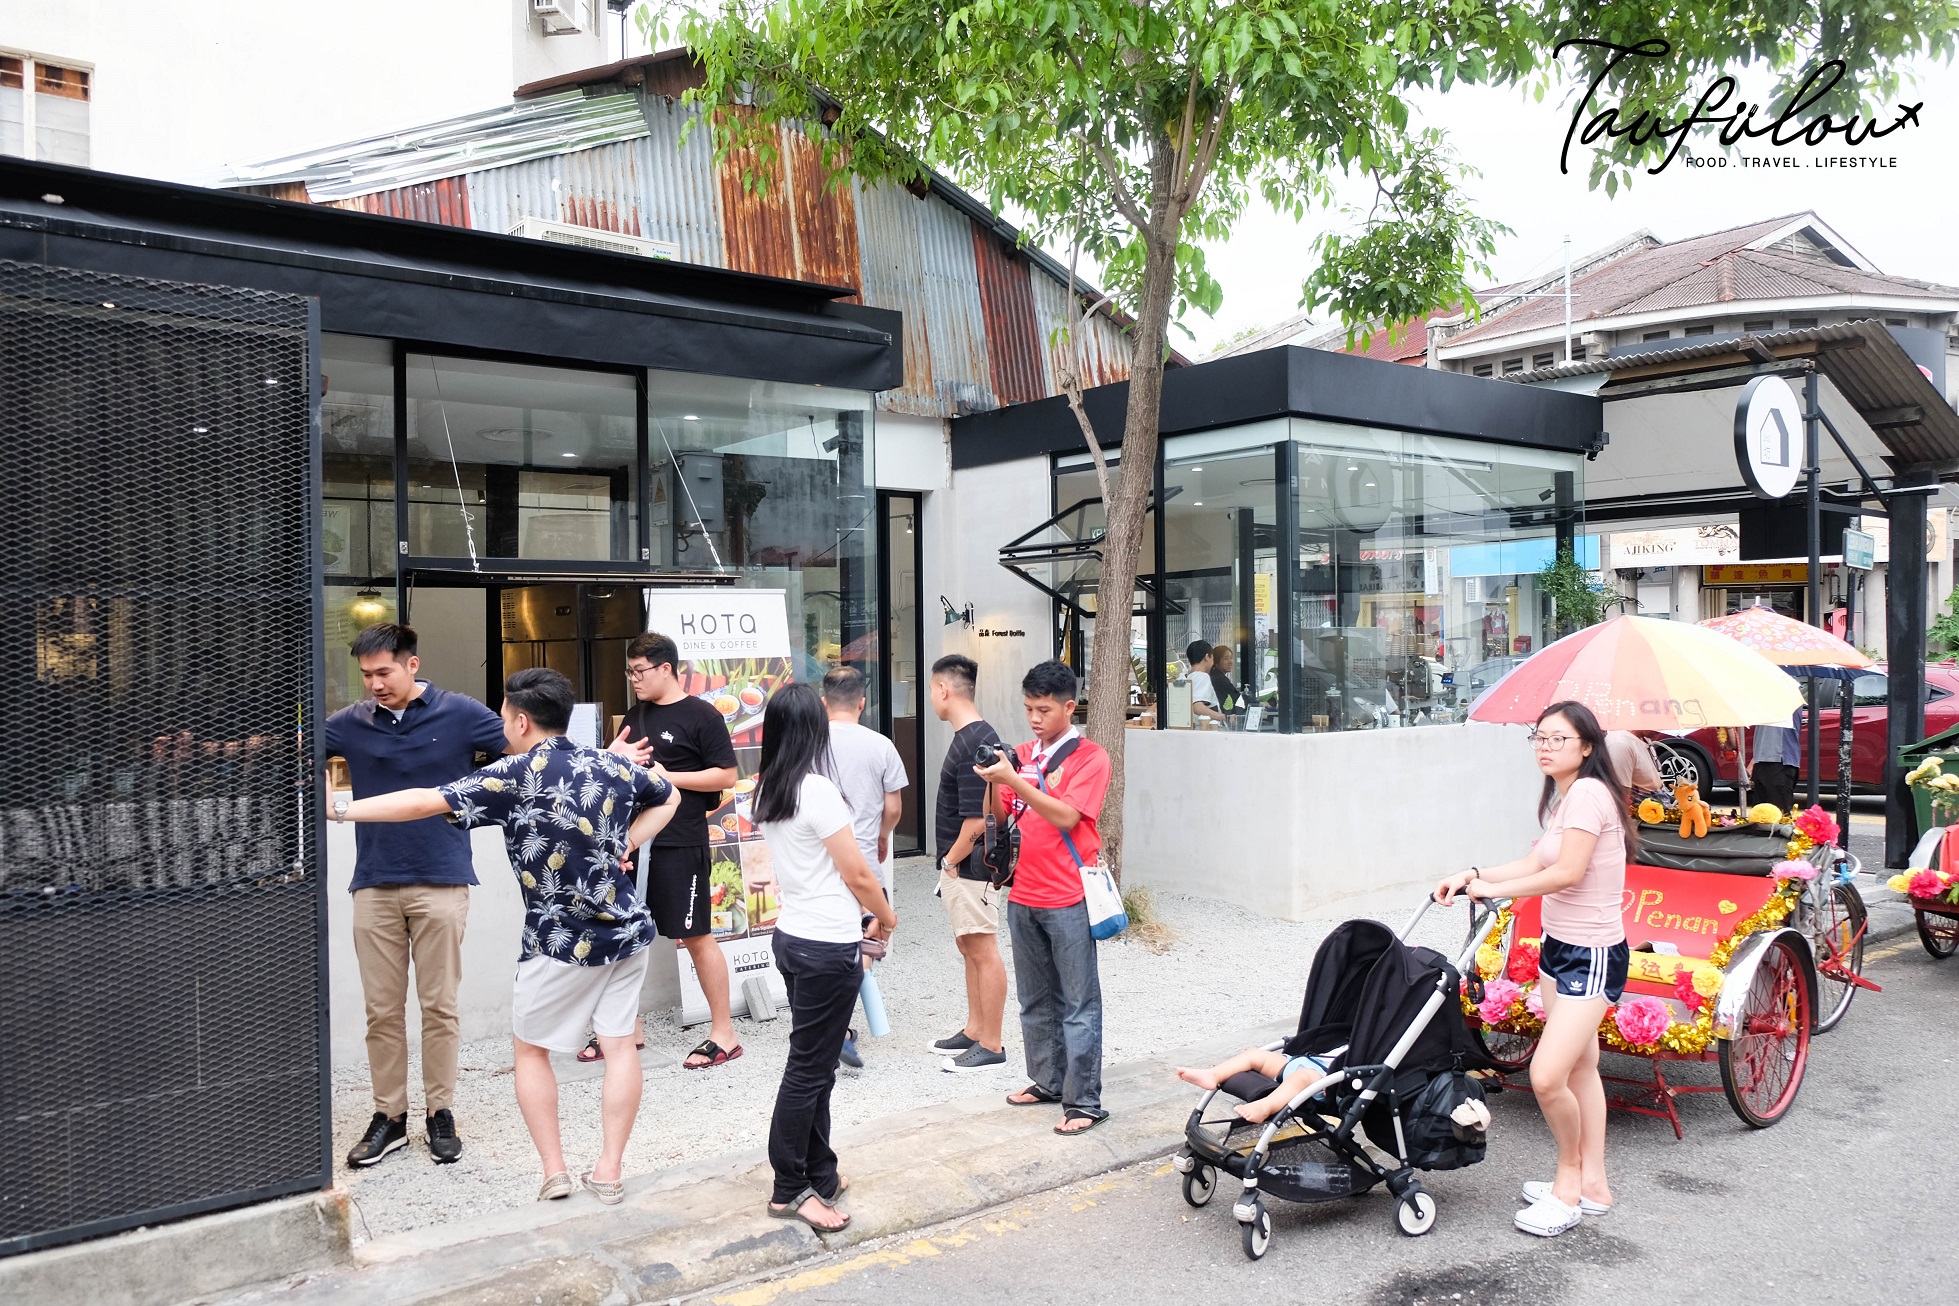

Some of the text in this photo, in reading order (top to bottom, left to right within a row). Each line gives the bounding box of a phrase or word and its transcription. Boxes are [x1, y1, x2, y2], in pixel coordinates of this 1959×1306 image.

[1624, 544, 1673, 556] AJIKING
[683, 642, 706, 650] DINE
[720, 640, 758, 649] COFFEE
[685, 874, 698, 930] Champion
